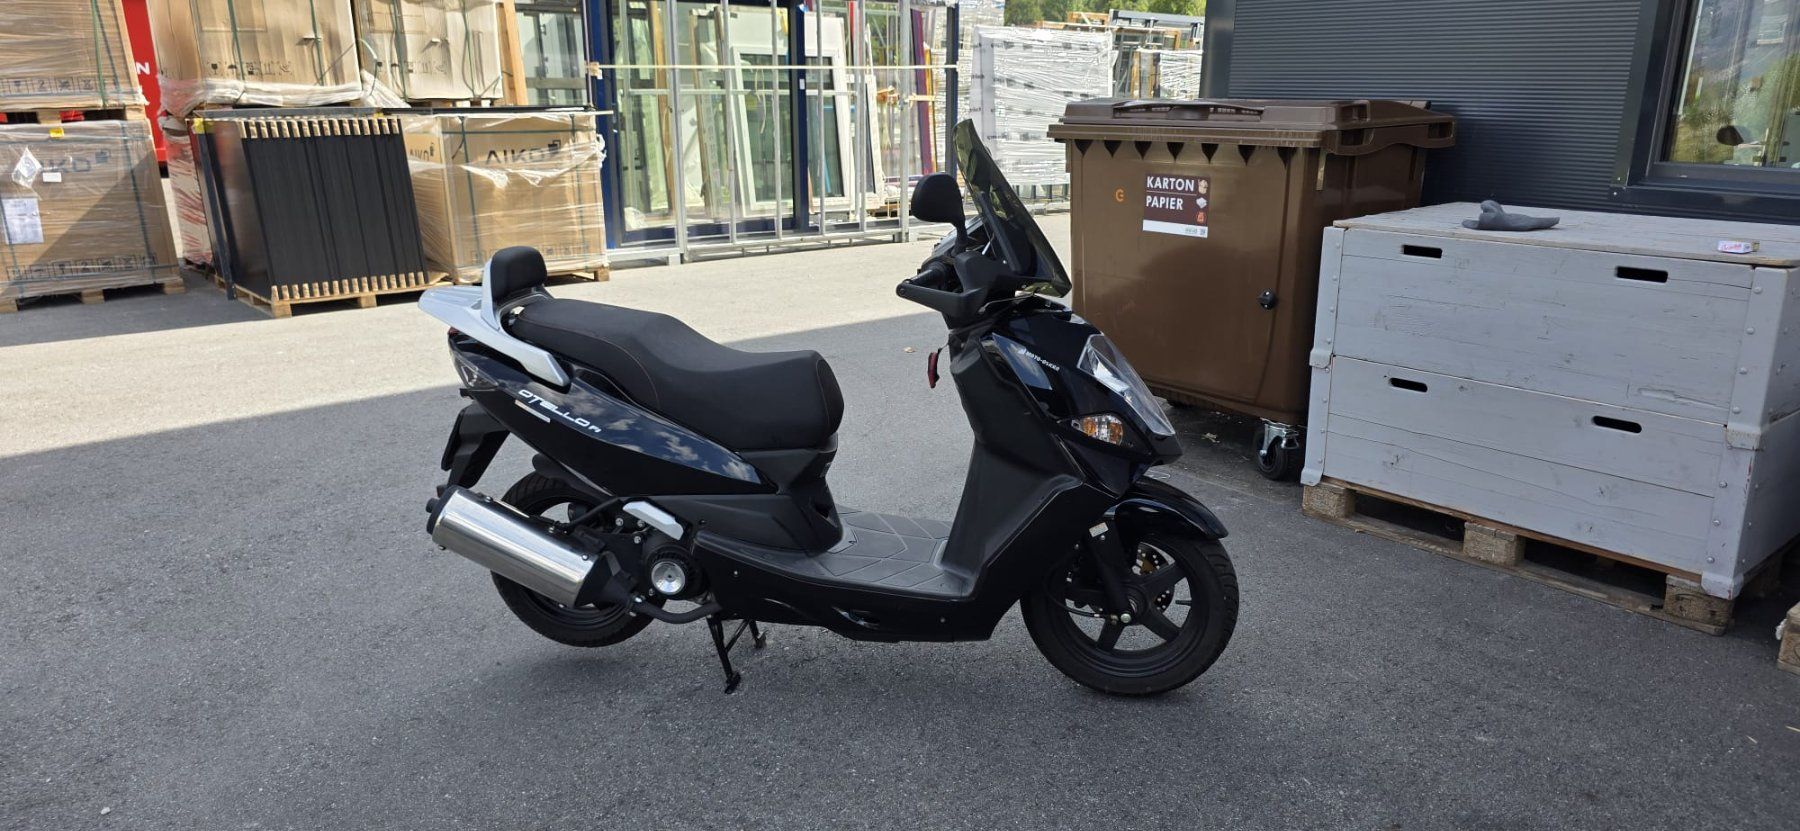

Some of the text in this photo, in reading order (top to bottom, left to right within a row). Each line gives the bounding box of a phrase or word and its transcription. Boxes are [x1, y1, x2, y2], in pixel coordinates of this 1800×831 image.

[135, 61, 151, 75] N
[1146, 176, 1195, 192] KARTON
[1146, 195, 1184, 211] PAPIER
[518, 389, 591, 428] OTELLO
